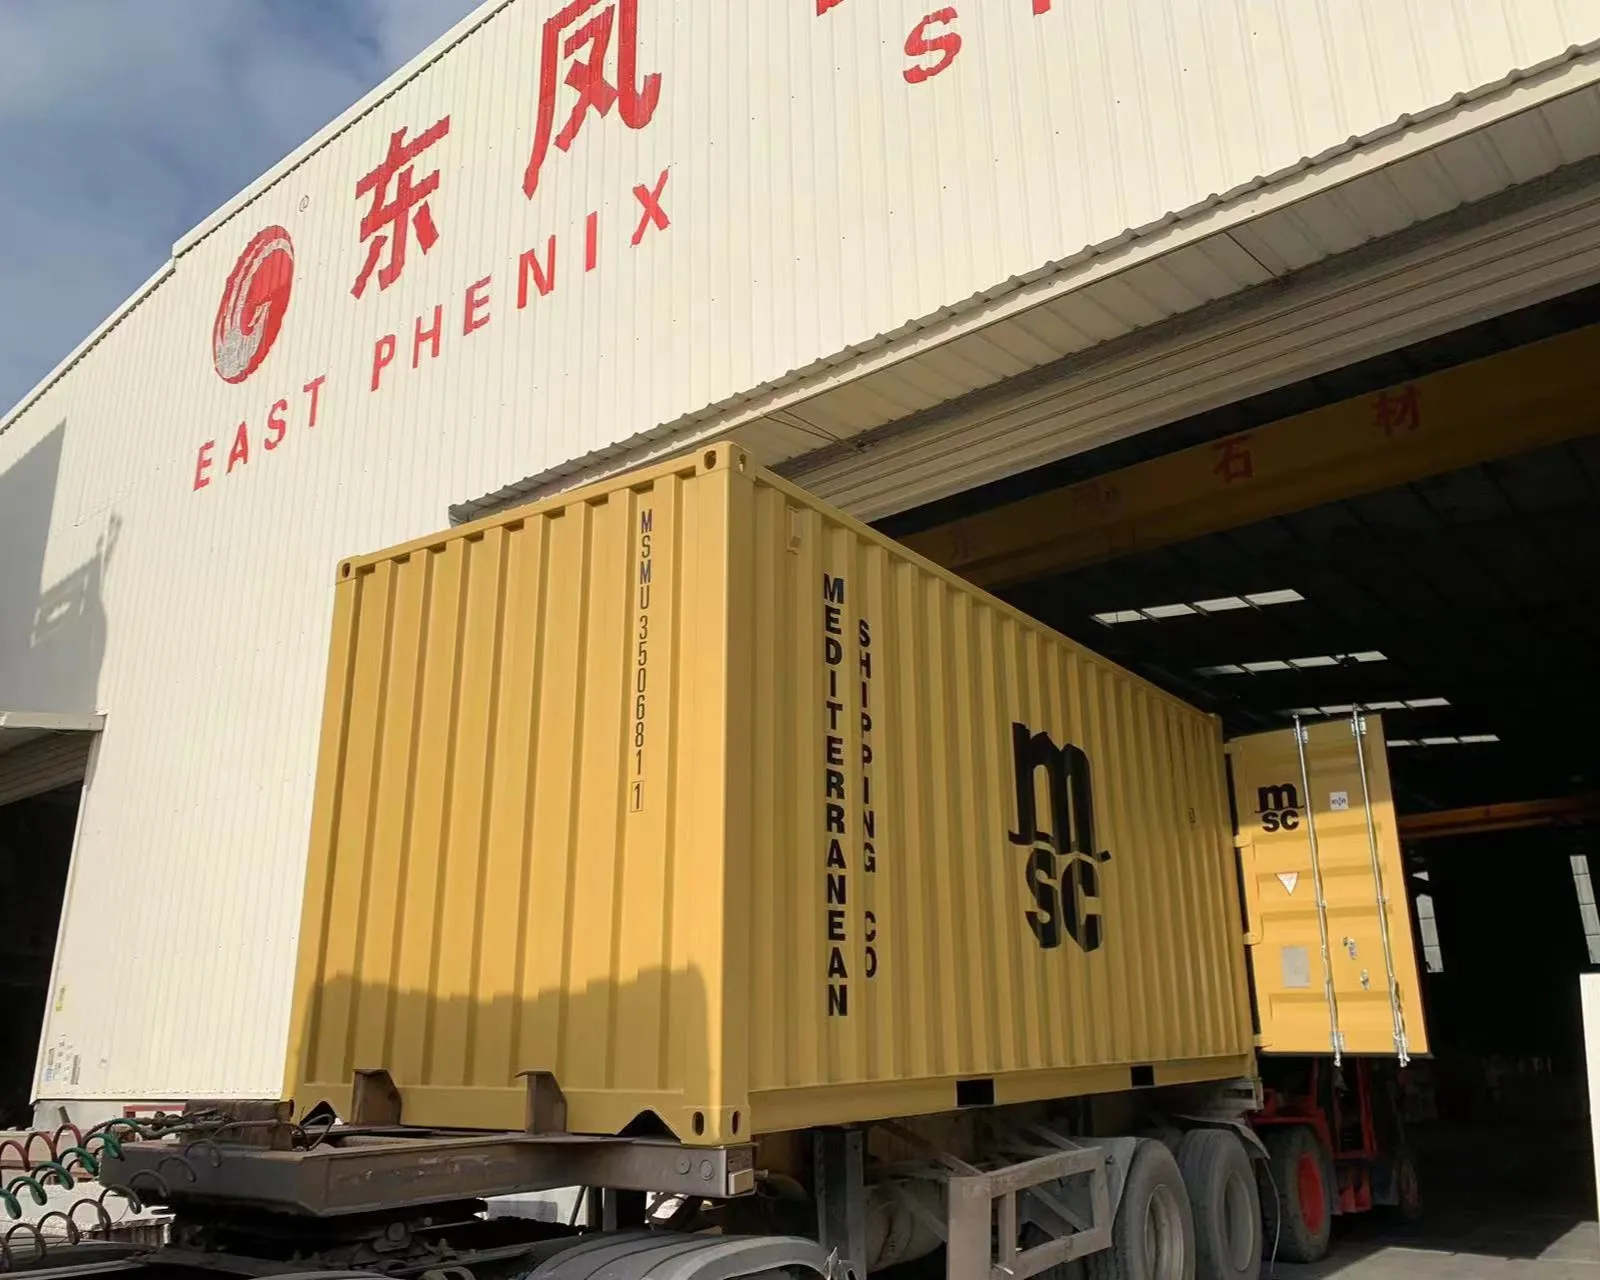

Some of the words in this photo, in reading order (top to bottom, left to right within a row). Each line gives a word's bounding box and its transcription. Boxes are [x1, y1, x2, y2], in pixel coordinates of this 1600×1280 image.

[193, 374, 326, 492] EAST
[371, 168, 671, 393] PHENIX
[823, 572, 849, 1017] MEDITERRANEAN
[859, 619, 877, 873] SHIPPING
